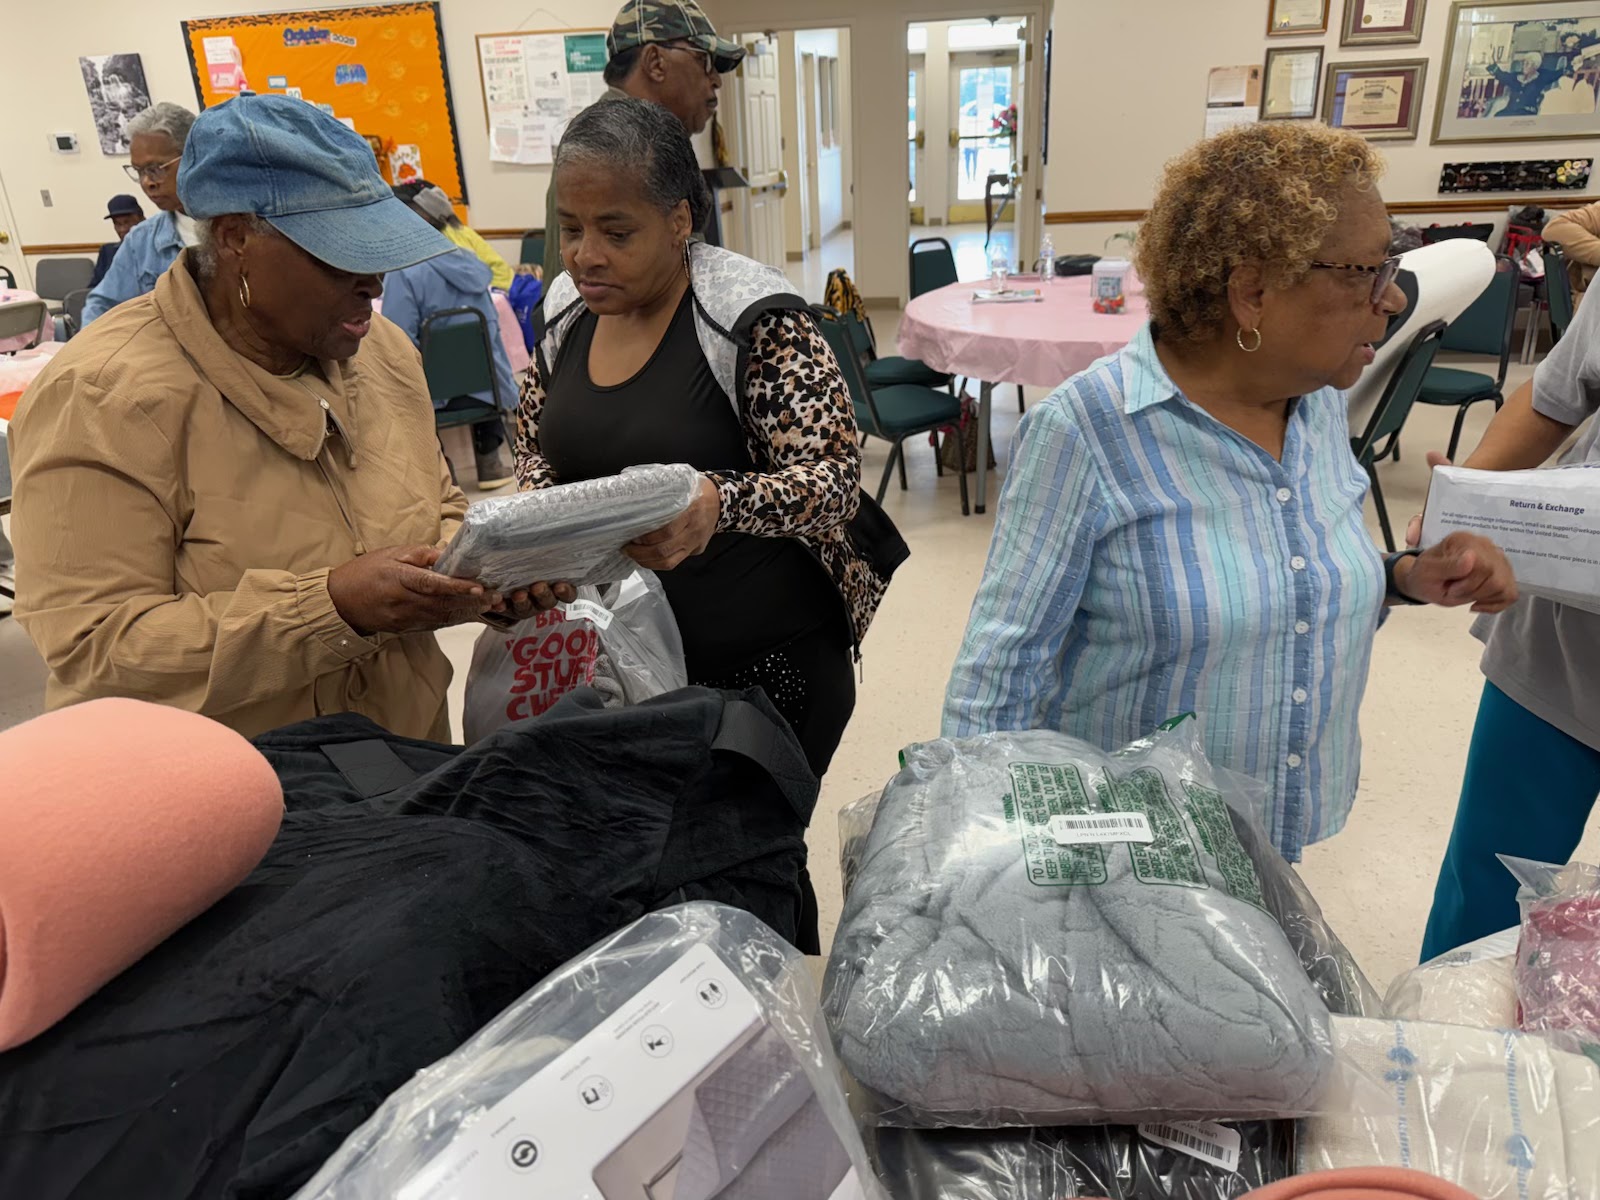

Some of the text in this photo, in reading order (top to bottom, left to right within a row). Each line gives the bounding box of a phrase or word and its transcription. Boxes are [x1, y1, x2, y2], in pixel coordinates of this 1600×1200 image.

[283, 26, 330, 41] October
[1510, 500, 1585, 515] Return & Exchange
[1472, 522, 1492, 530] products
[1474, 515, 1495, 523] exchange
[1495, 518, 1524, 526] information,
[1041, 774, 1052, 785] NOT
[1045, 786, 1055, 795] DO
[1022, 800, 1032, 809] OF
[1034, 795, 1044, 808] BAG
[1045, 859, 1058, 879] KEEP
[1059, 852, 1072, 879] BABIES
[1074, 861, 1087, 878] THIS
[1137, 857, 1151, 878] POUR
[1033, 868, 1044, 879] TO
[1088, 866, 1101, 878] OR
